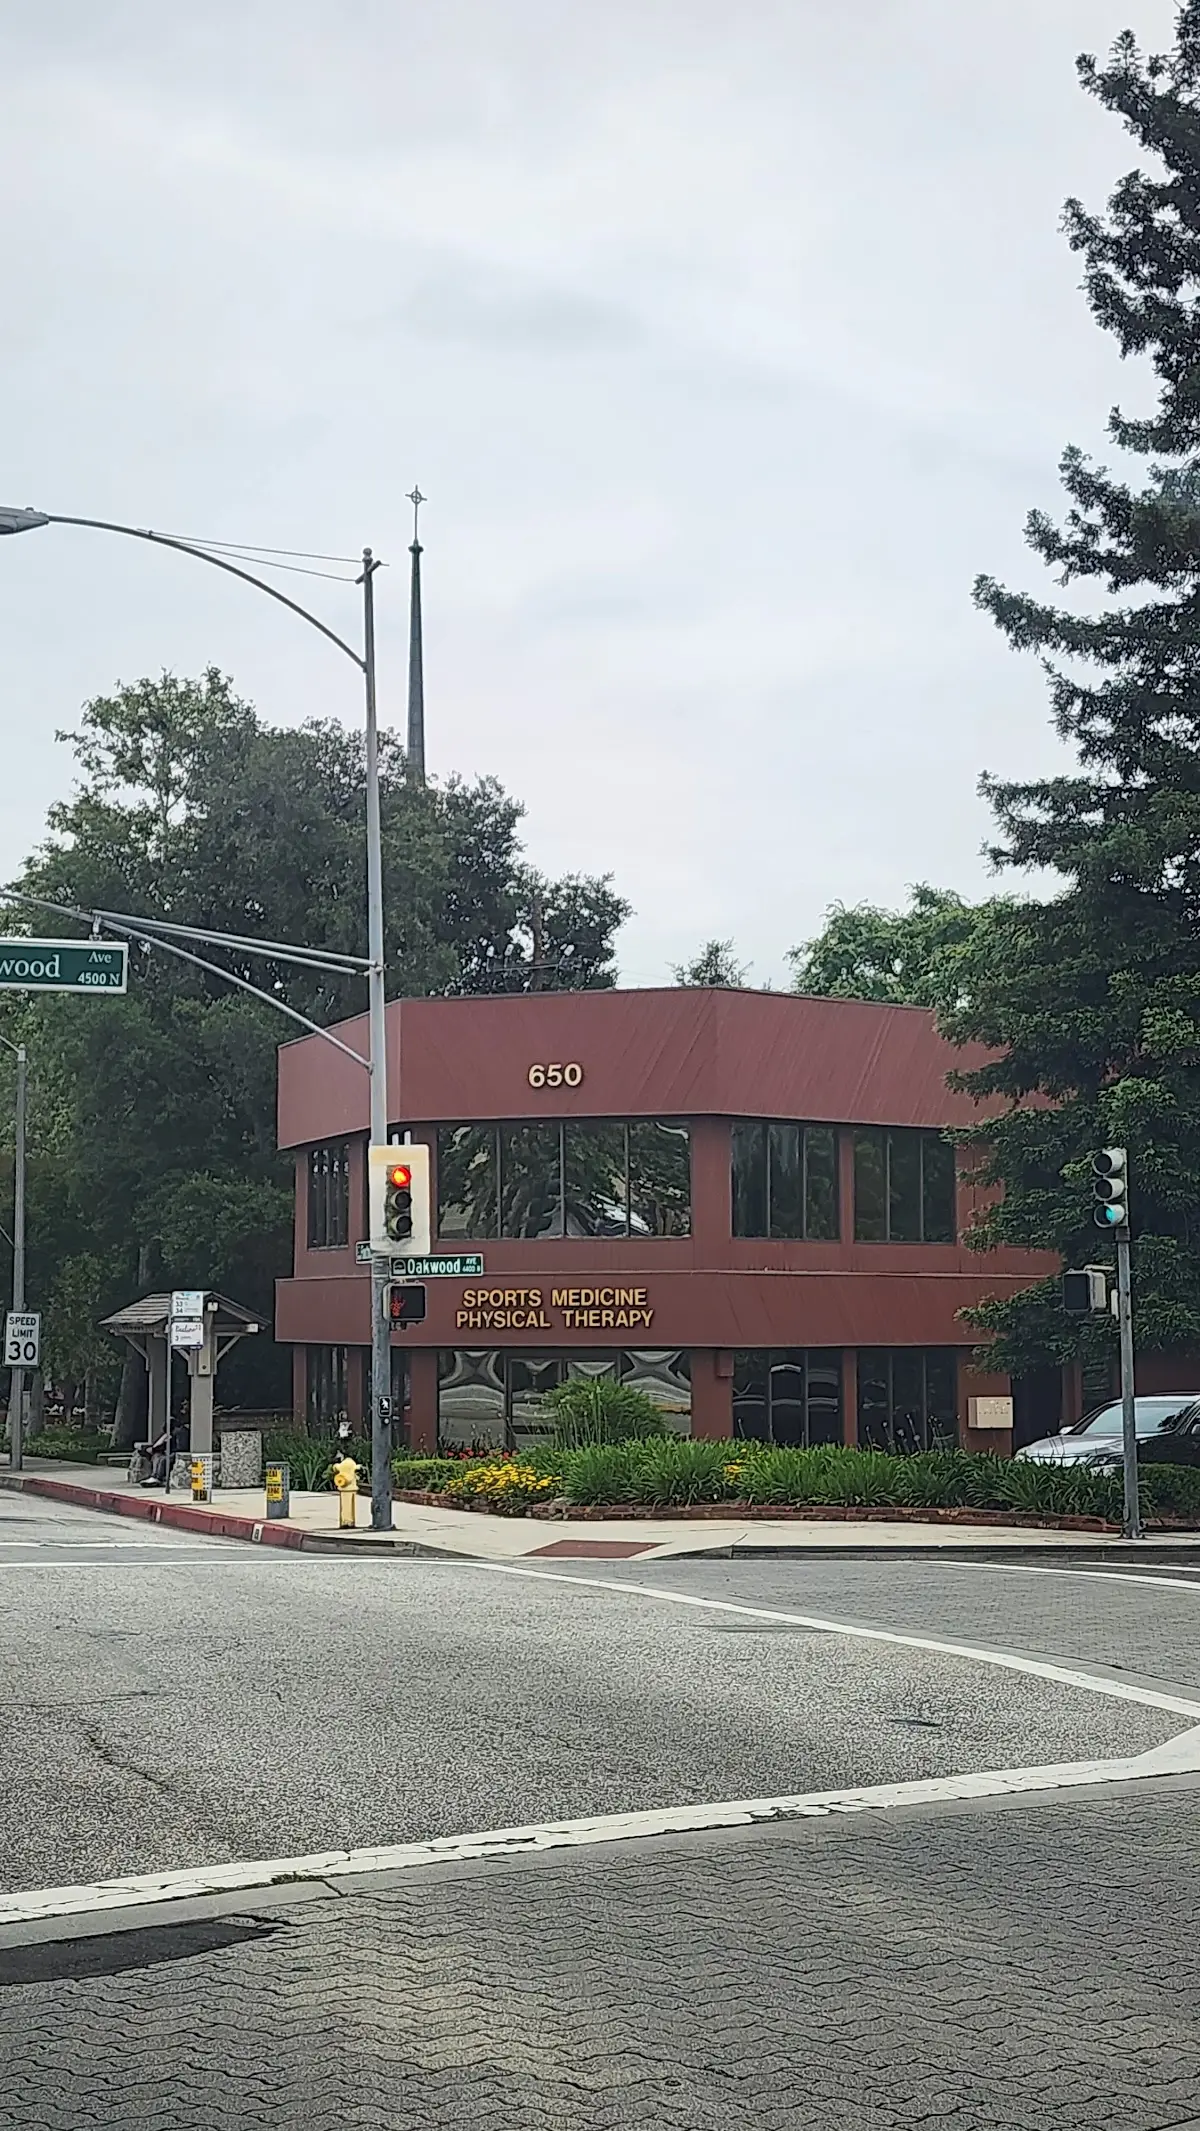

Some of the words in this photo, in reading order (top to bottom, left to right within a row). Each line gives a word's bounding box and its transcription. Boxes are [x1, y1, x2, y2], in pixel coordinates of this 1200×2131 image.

[0, 954, 61, 978] wood
[88, 951, 112, 964] Ave
[77, 972, 107, 985] 4500
[109, 973, 120, 985] N
[528, 1062, 582, 1087] 650
[407, 1258, 460, 1274] Oakwood
[466, 1257, 477, 1265] AVE
[463, 1289, 542, 1307] SPORTS
[552, 1288, 647, 1306] MEDICINE
[9, 1316, 37, 1326] SPEED
[456, 1310, 551, 1328] PHYSICAL
[562, 1310, 654, 1328] THERAPY
[12, 1329, 34, 1338] LIMIT
[8, 1341, 37, 1361] 30
